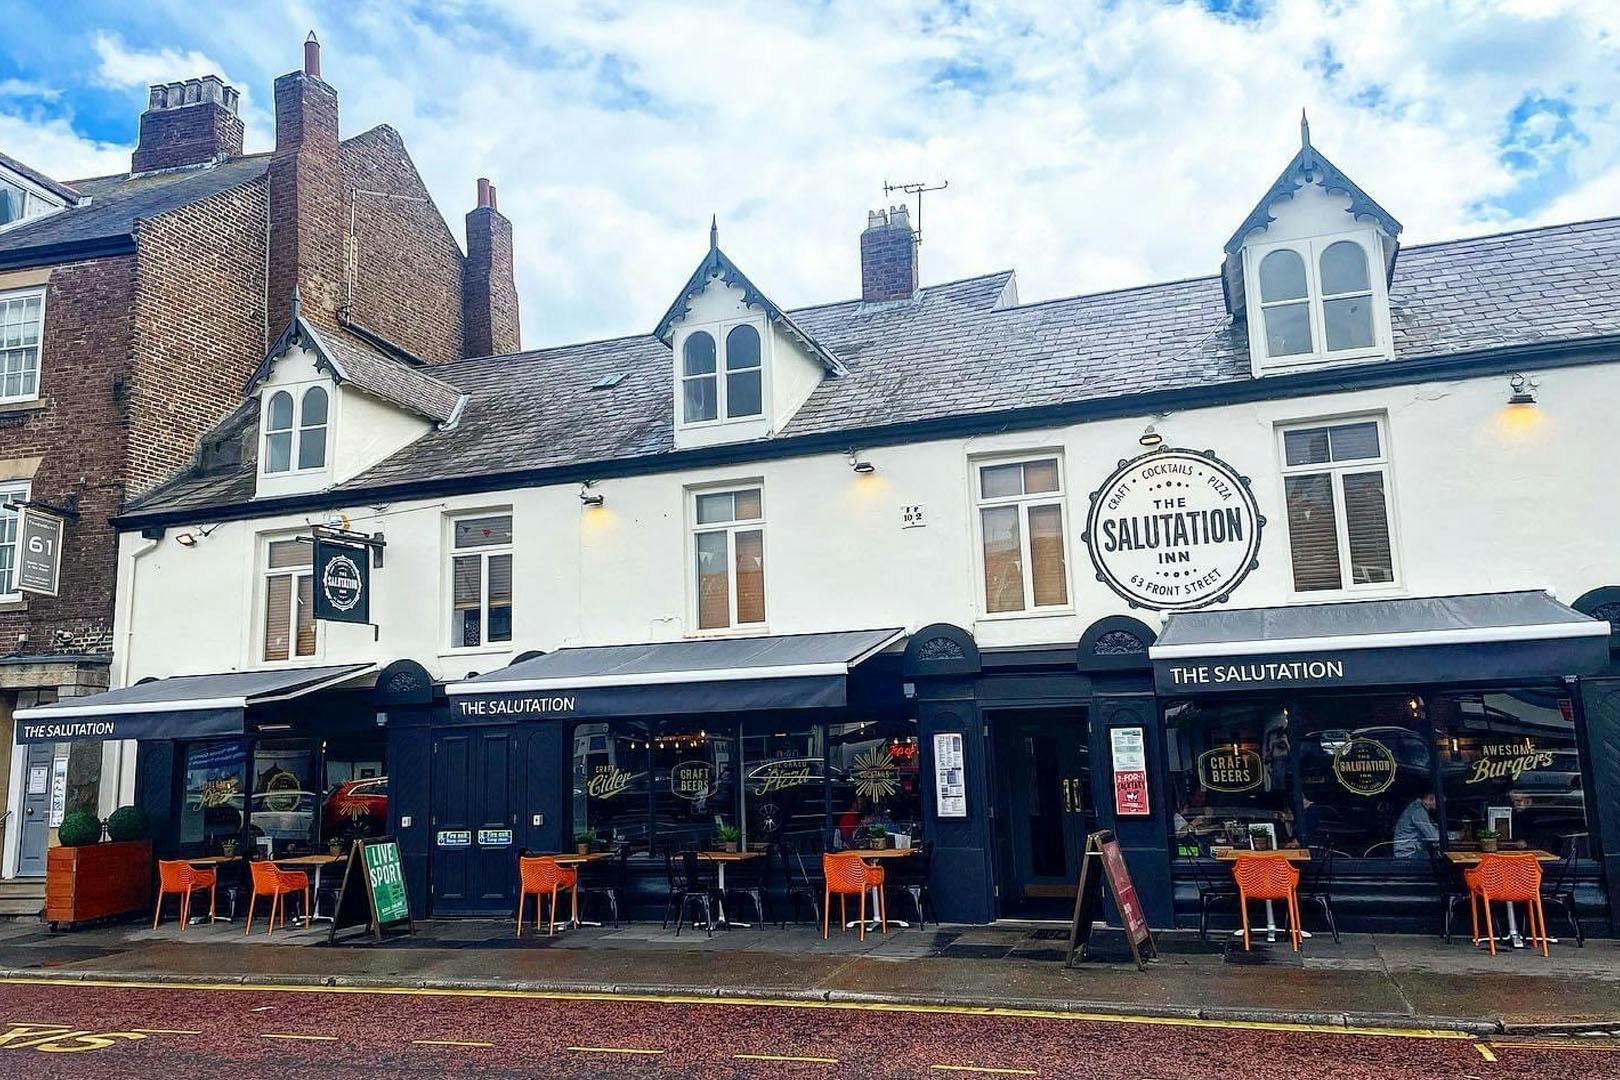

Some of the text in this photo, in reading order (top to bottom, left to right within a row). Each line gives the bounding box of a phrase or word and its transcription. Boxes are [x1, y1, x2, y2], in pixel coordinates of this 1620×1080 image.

[1108, 464, 1233, 510] CRAFT COCKTAILS PIZZA
[1154, 498, 1187, 510] THE
[1103, 507, 1243, 552] SALUTATION
[28, 536, 53, 556] 61
[1158, 551, 1191, 565] INN
[1130, 568, 1222, 596] 63 FRONT STREET
[1170, 661, 1343, 684] THE SALUTATION
[459, 697, 576, 715] THE SALUTATION
[24, 722, 115, 738] THE SALUTATION
[1483, 743, 1536, 756] AWESOME
[1210, 755, 1250, 770] CRAFT
[1340, 760, 1391, 772] SALUTATION
[1465, 752, 1553, 784] Burgers
[587, 768, 631, 797] Cider
[680, 768, 710, 780] CRAFT
[755, 767, 810, 796] Pizza
[1212, 770, 1251, 783] BEERS
[681, 780, 710, 792] BEERS
[371, 844, 394, 866] LIVE
[370, 862, 401, 887] SPORT
